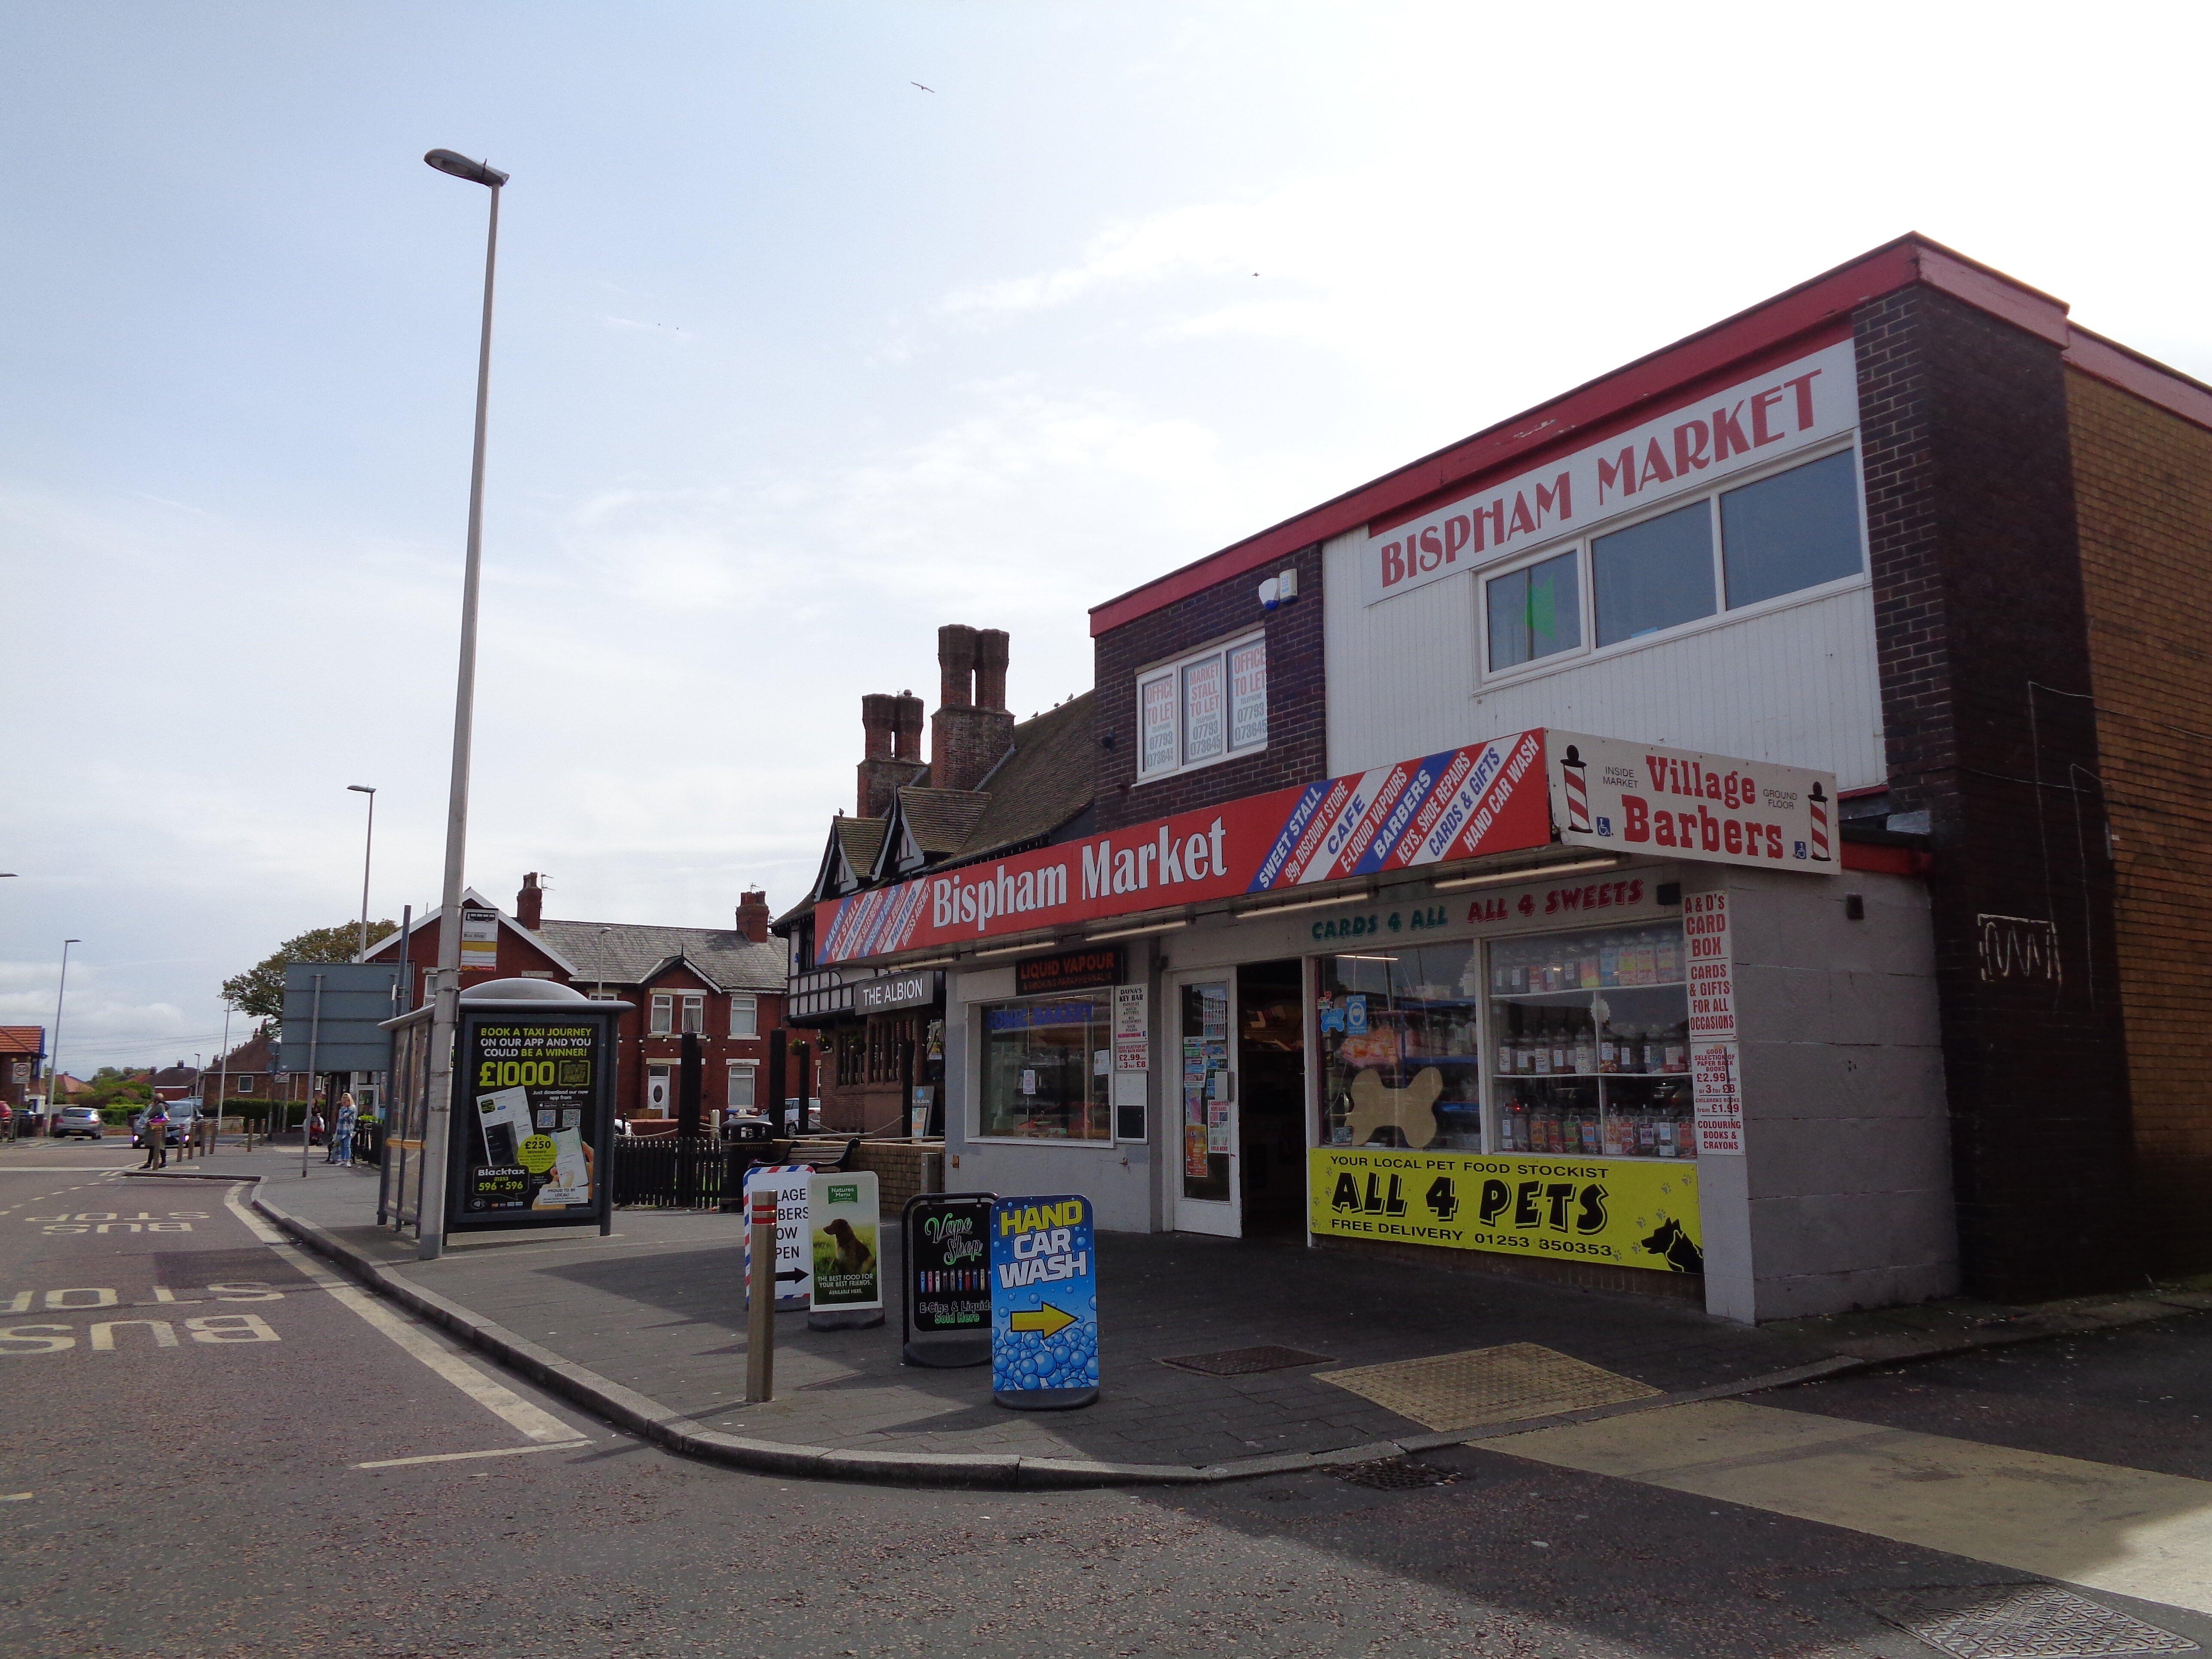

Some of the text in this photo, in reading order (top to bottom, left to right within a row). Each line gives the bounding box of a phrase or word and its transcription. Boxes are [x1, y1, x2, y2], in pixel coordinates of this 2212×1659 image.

[1380, 368, 1822, 588] BISPHAM MARKET
[1234, 646, 1265, 674] OFFICE
[1190, 662, 1219, 685] MARKET
[1234, 670, 1265, 697] TO LET
[1192, 680, 1217, 701] STALL
[1147, 701, 1173, 726] TO LET
[1190, 695, 1220, 717] TO LET
[1237, 702, 1264, 723] 07793
[1149, 731, 1173, 750] 07793
[1193, 720, 1218, 740] 07793
[1234, 719, 1267, 741] 073645
[1190, 735, 1221, 756] 073645
[1603, 776, 1639, 789] MARKET
[1605, 766, 1635, 778] INSIDE
[1646, 755, 1756, 809] Village
[1428, 747, 1501, 857] CARDS & GIFTS
[1462, 734, 1540, 852] HAND CAR WASH
[1763, 788, 1798, 800] GROUND
[1768, 799, 1795, 810] FLOOR
[1340, 766, 1407, 873] E-LIQUID VAPOURS
[1373, 770, 1431, 860] BARBERS
[1396, 751, 1471, 866] KEYS, SHOE REPAIRS
[1285, 780, 1349, 883] 99p DISCOUNT STORE
[1328, 793, 1366, 855] CAFE
[1621, 794, 1784, 860] Barbers
[1259, 787, 1322, 889] SWEET STALL
[933, 816, 1228, 931] Bispham Market
[1467, 879, 1644, 923] ALL 4 SWEETS
[1685, 896, 1692, 913] A
[1695, 896, 1703, 912] &
[863, 886, 896, 957] HOUSEHOLD GOODS
[890, 887, 917, 945] PRINTERS
[902, 881, 930, 947] DRESS AGENCY
[1311, 905, 1449, 941] CARDS 4 ALL
[1686, 914, 1726, 935] CARD
[825, 905, 845, 952] BAKERY
[831, 900, 859, 960] PET STALL
[841, 895, 871, 958] VINYL RECORDS
[1692, 936, 1722, 957] BOX
[1020, 952, 1114, 979] LIQUID VAPOUR
[1691, 963, 1727, 980] CARDS
[863, 978, 923, 1006] THE ALBION
[1689, 980, 1730, 997] & GIFTS
[1693, 998, 1729, 1013] FOR ALL
[481, 1028, 592, 1036] BOOK A TAXI JOURNEY
[1690, 1015, 1734, 1030] OCCASIONS
[480, 1038, 591, 1046] ON OUR APP AND YOU
[484, 1048, 519, 1057] COULD
[521, 1048, 534, 1057] BE
[545, 1048, 587, 1056] WINNER!
[480, 1061, 555, 1086] £1000
[1696, 1073, 1726, 1082] £2.99
[1705, 1084, 1711, 1094] 3
[1722, 1084, 1735, 1094] £8
[1711, 1104, 1739, 1113] £1.99
[1698, 1121, 1741, 1129] COLOURING
[1704, 1131, 1729, 1139] BOOKS
[525, 1141, 551, 1149] £250
[1704, 1141, 1738, 1150] CRAYONS
[1330, 1155, 1609, 1179] YOUR LOCAL PET FOOD STOCKIST
[478, 1181, 523, 1191] 596 596
[1331, 1171, 1610, 1236] ALL 4 PETS
[25, 1211, 211, 1222] STOP
[41, 1222, 193, 1235] BUS
[925, 1213, 973, 1243] Vape
[1000, 1200, 1083, 1237] HAND
[1013, 1228, 1072, 1260] CAR
[1331, 1218, 1613, 1257] FREE DELIVERY 01253 350353
[944, 1235, 983, 1265] Shop
[998, 1250, 1088, 1289] WASH
[920, 1302, 948, 1315] E-Cigs
[951, 1301, 958, 1312] &
[935, 1312, 980, 1324] Sold Here
[0, 1314, 282, 1355] BUS
